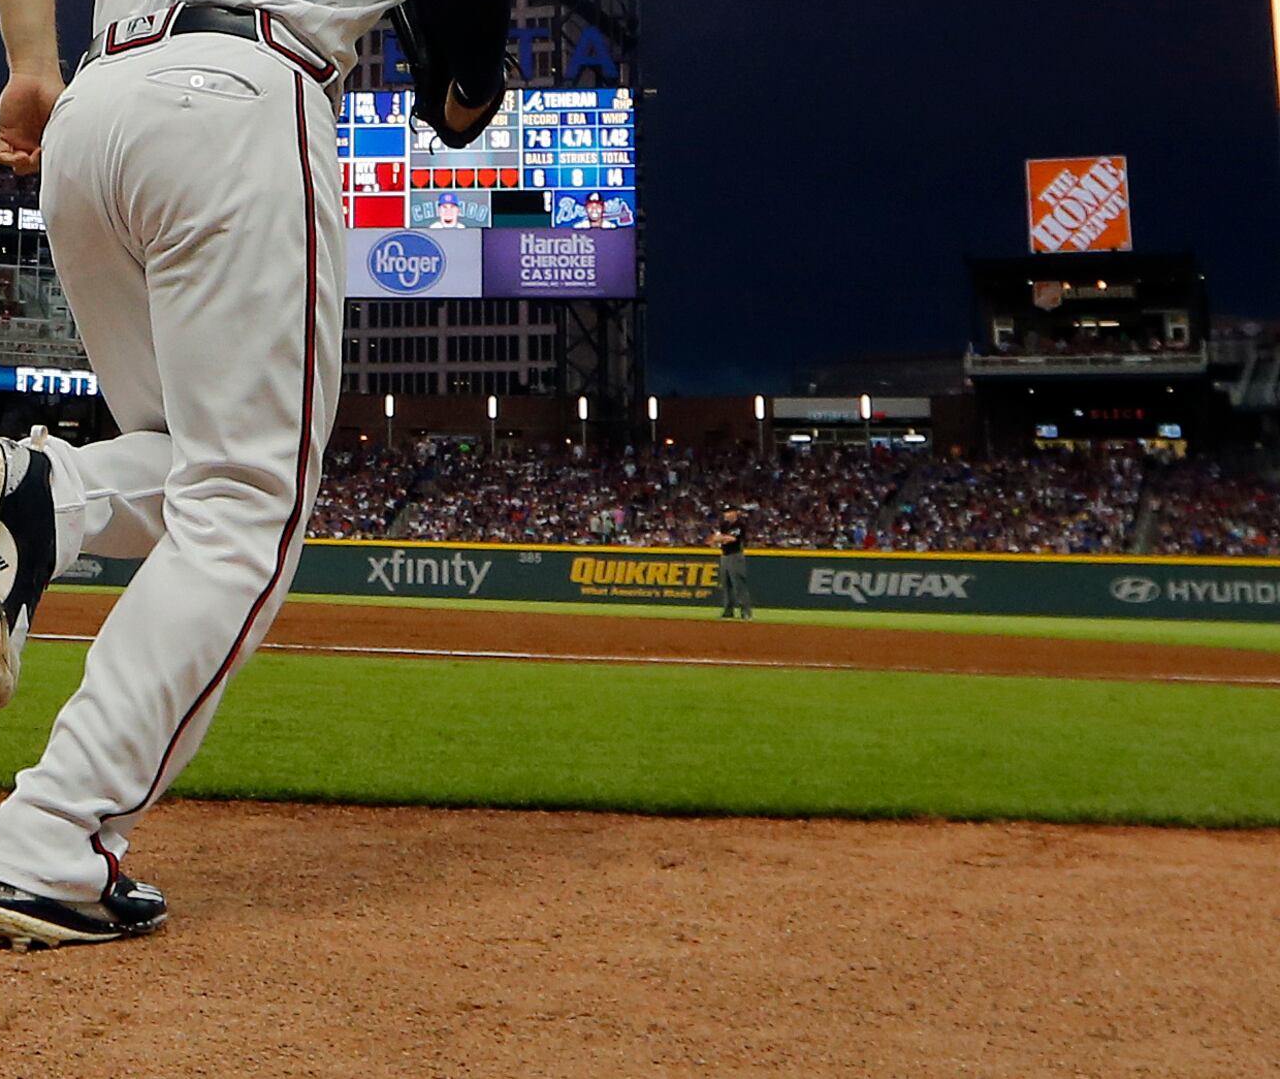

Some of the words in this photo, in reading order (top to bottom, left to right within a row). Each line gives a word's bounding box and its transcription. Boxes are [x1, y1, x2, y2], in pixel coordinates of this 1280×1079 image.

[542, 91, 597, 107] TEHERAN
[523, 114, 558, 125] RECORD
[567, 113, 586, 125] ERA
[601, 112, 628, 124] WHIP
[562, 129, 592, 147] 4.74
[600, 128, 629, 147] 1.42
[525, 153, 554, 164] BALLS
[559, 153, 598, 164] STRIKES
[601, 152, 630, 164] TOTAL
[1038, 168, 1080, 206] THE
[1031, 156, 1126, 251] HOME
[1070, 191, 1129, 251] DEPOT
[520, 233, 595, 255] Harrah's
[376, 241, 440, 288] Kroger
[521, 255, 595, 268] CHEROKEE
[521, 269, 596, 280] CASINOS
[367, 550, 492, 594] xfinity
[570, 557, 721, 587] QUIKRETE
[808, 568, 969, 603] EQUIFAX
[1168, 581, 1280, 604] HYUND
